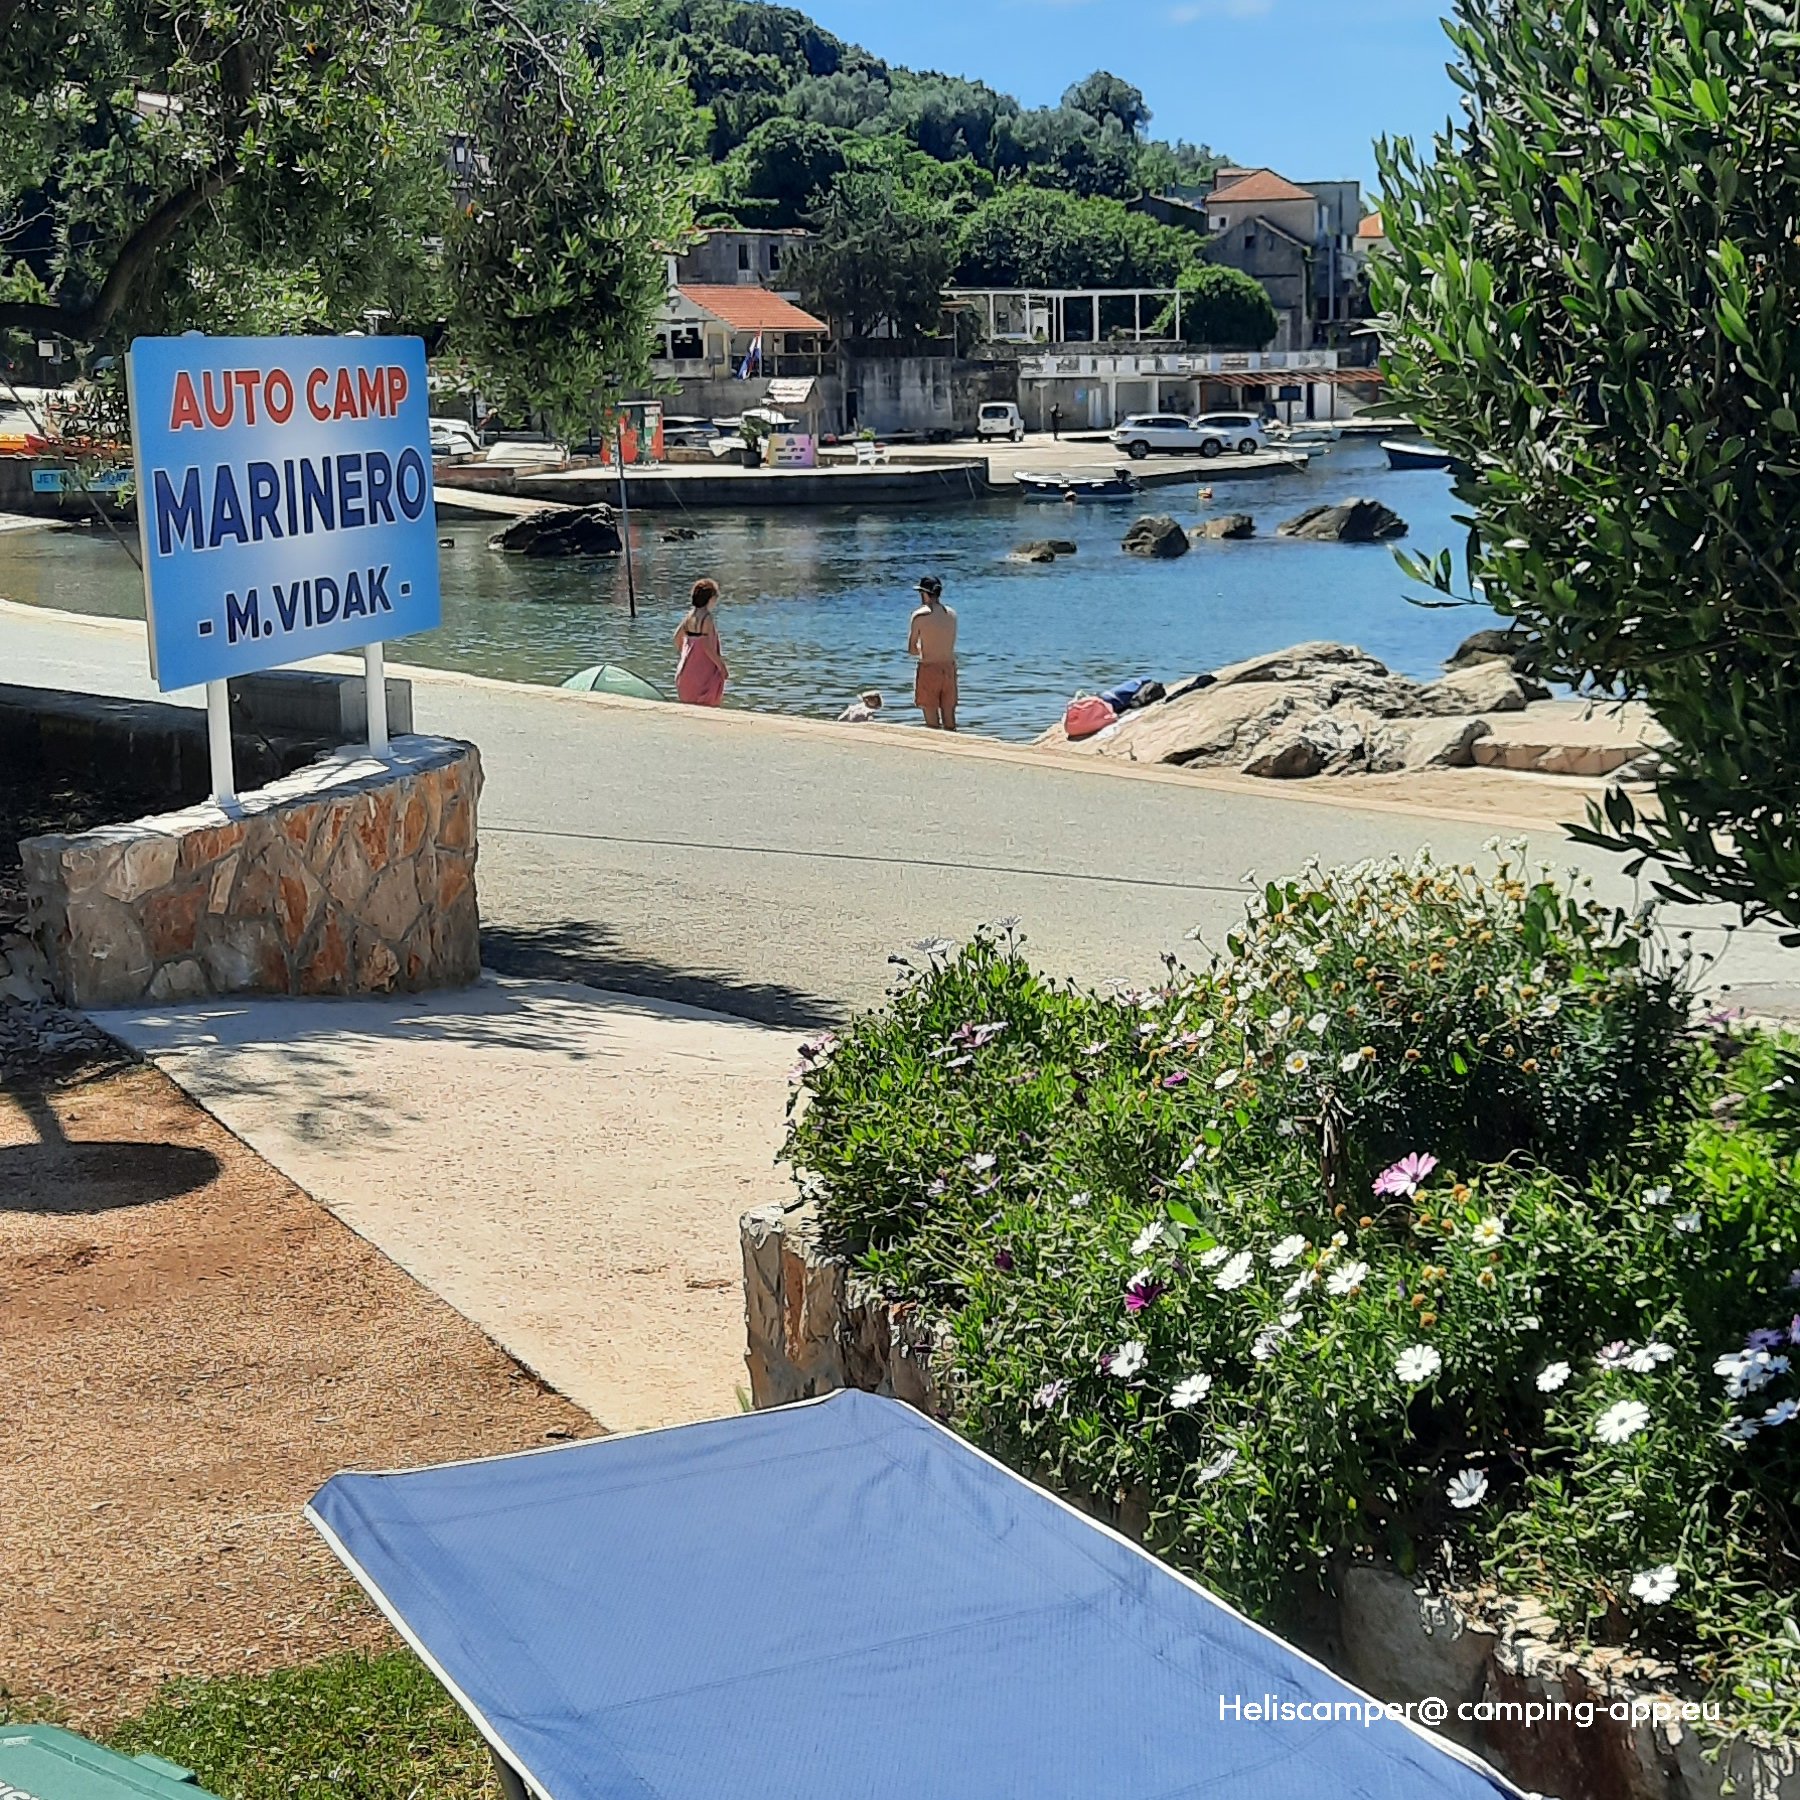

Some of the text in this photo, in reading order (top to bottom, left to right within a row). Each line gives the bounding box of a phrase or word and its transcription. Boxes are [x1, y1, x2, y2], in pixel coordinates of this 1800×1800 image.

[169, 366, 408, 431] AUTO CAMP
[153, 446, 427, 556] MARINERO
